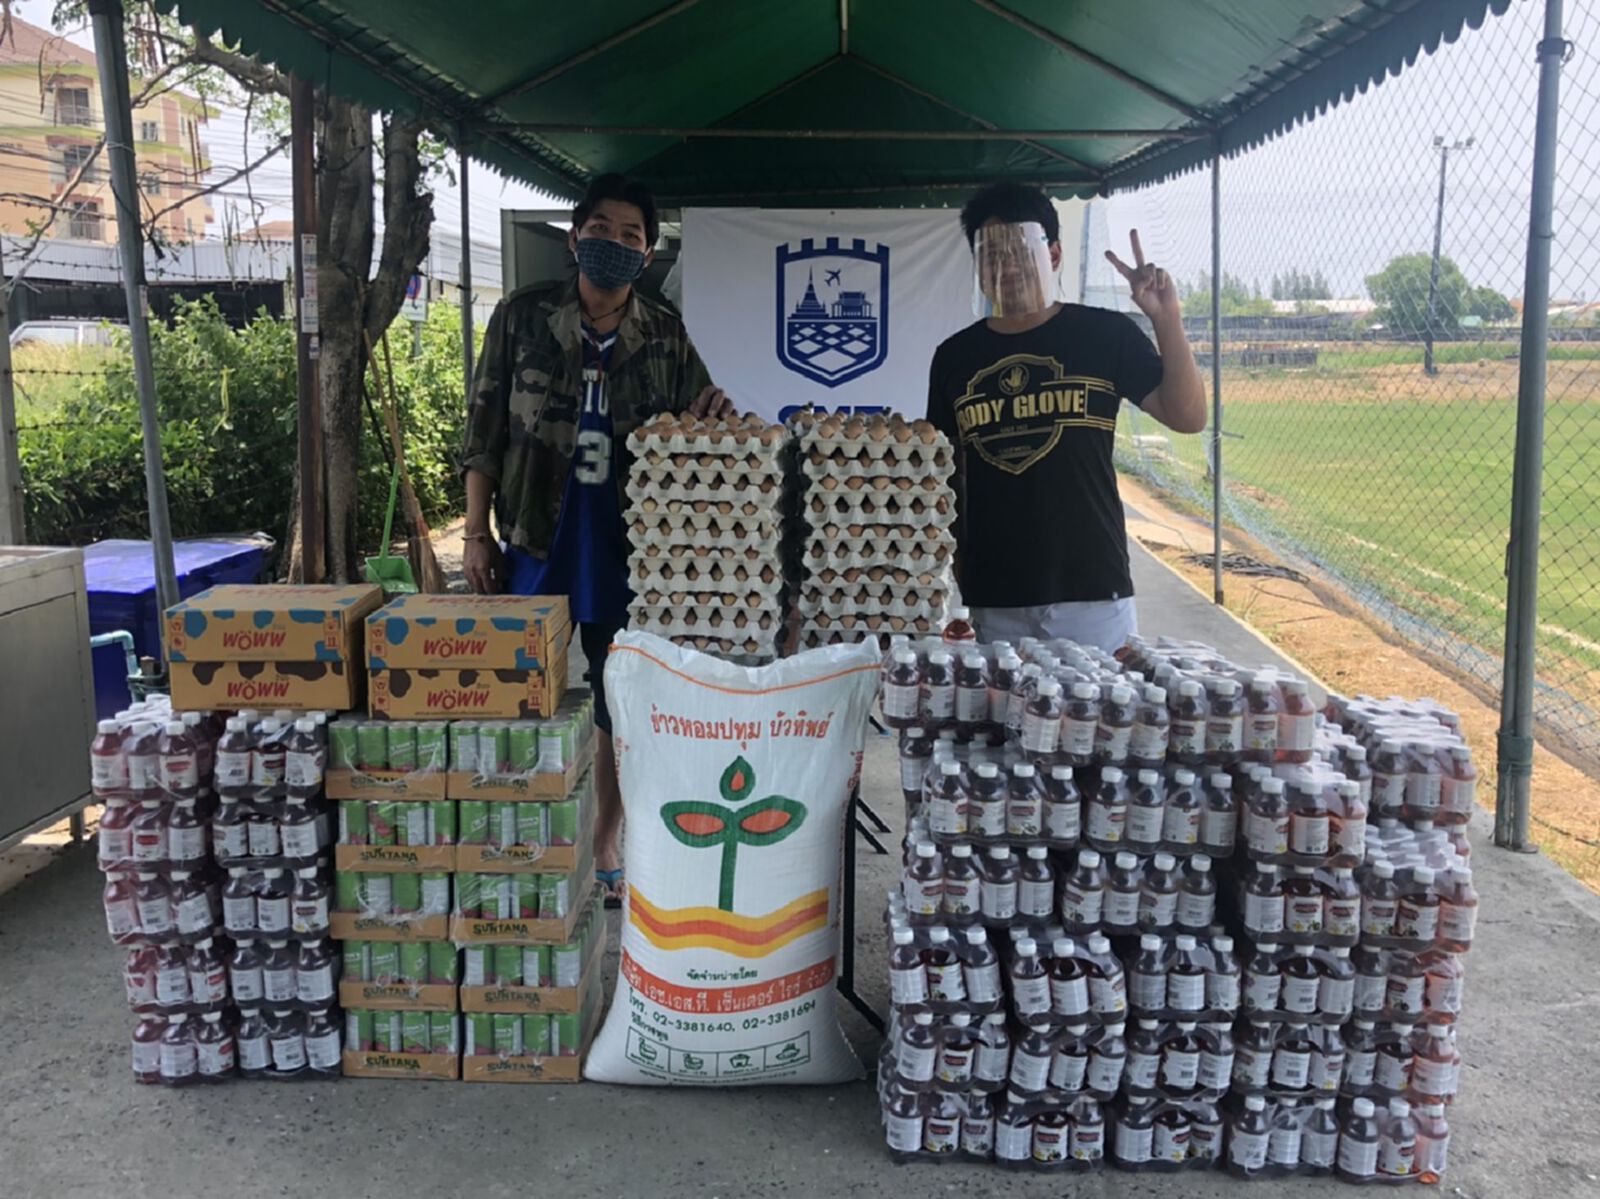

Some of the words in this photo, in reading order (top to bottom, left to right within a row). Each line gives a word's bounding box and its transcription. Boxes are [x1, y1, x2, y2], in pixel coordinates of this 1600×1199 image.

[1013, 389, 1085, 419] GLOVE
[575, 430, 612, 484] 3
[651, 703, 762, 751] ข้าวหอมปทุม
[770, 710, 835, 739] บัวทิพย์
